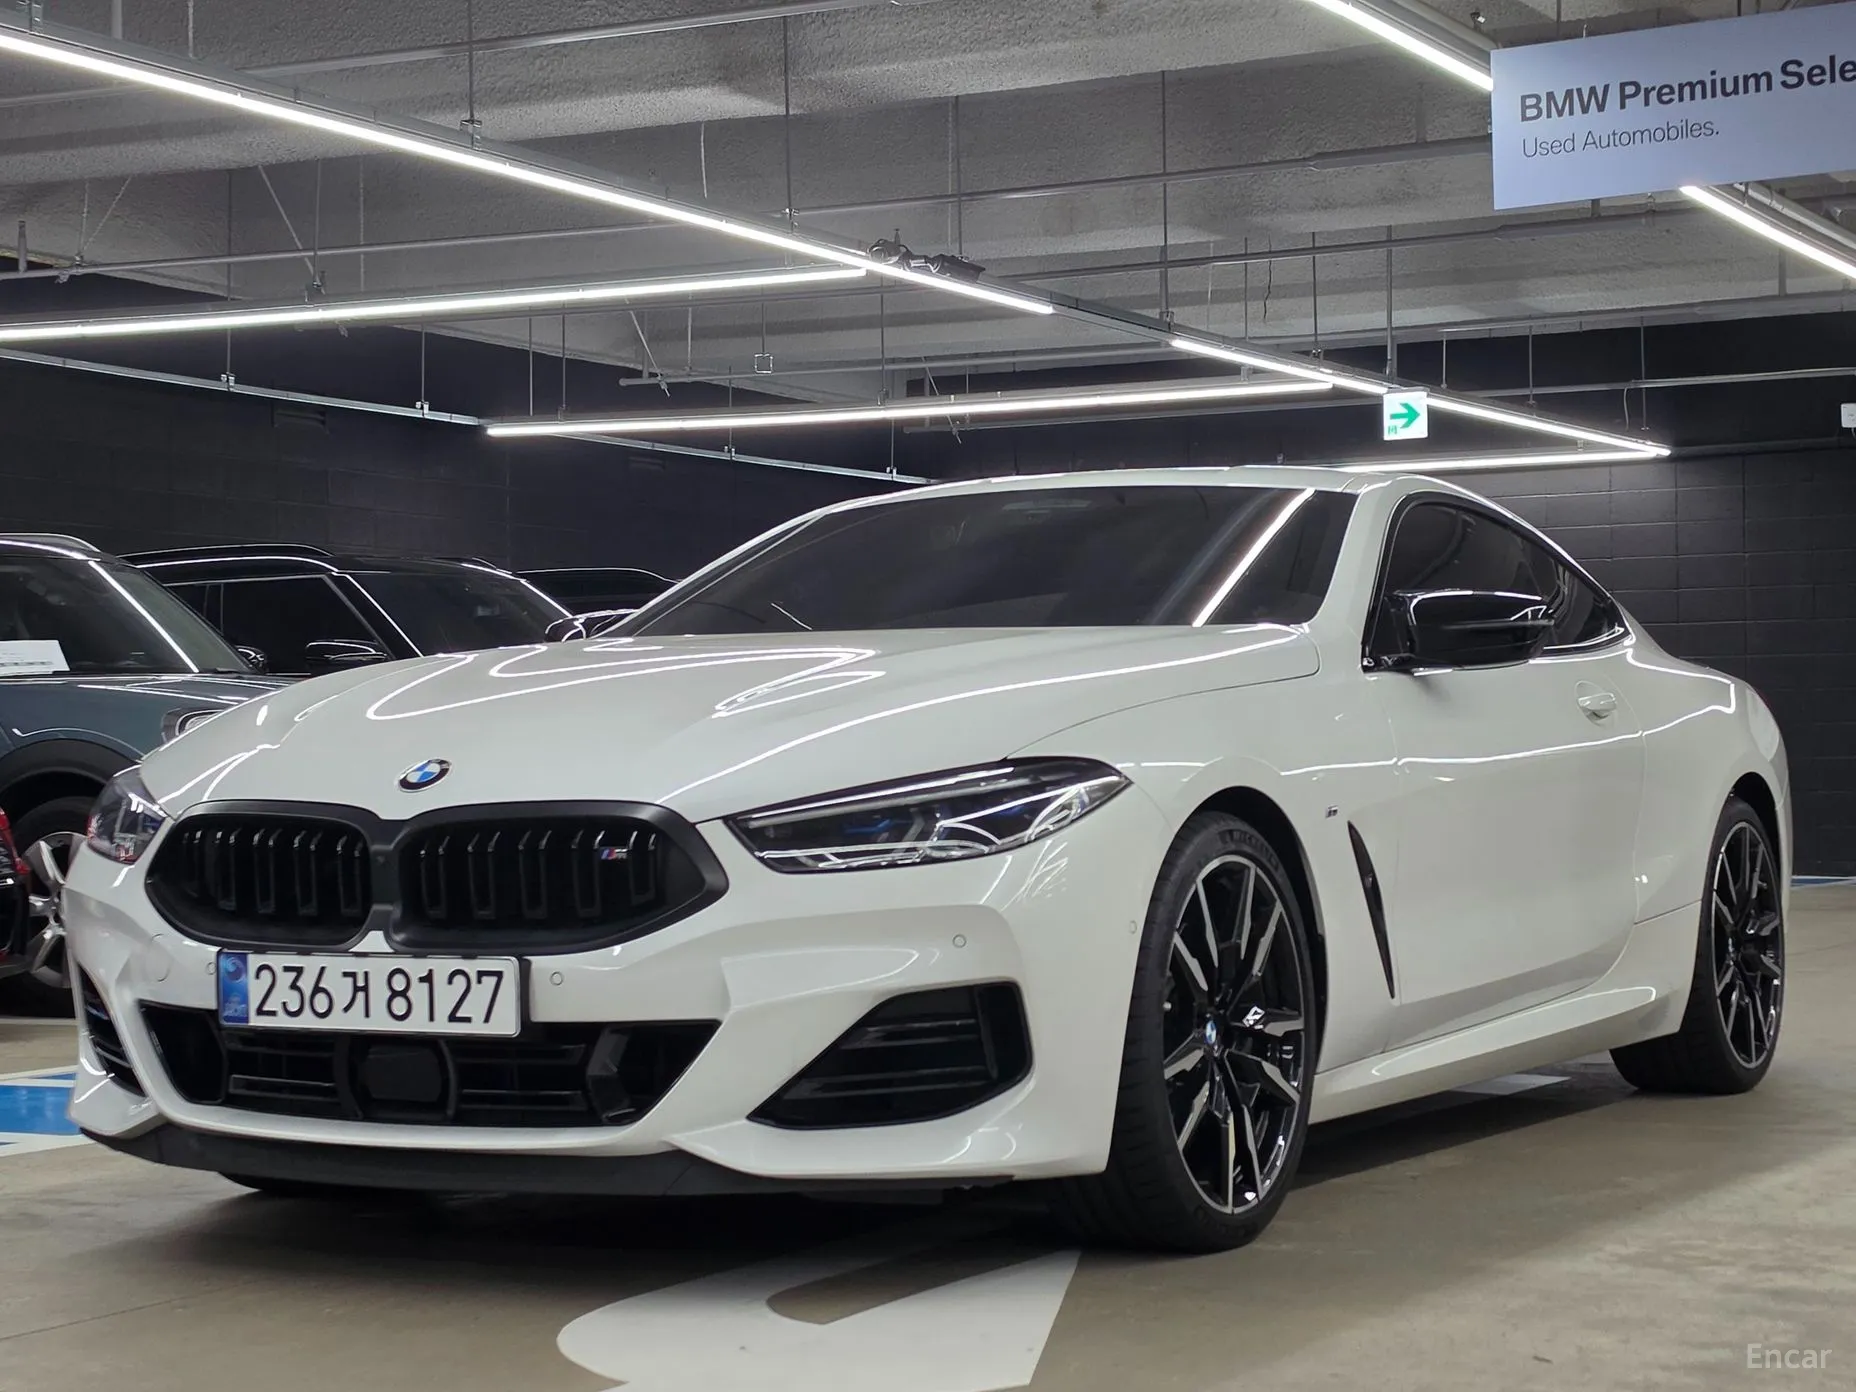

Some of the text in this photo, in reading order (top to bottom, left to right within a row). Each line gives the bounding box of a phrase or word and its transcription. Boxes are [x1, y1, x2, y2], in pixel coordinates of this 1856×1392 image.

[1520, 54, 1856, 122] BMW Premium Sele
[1522, 119, 1720, 158] Used Automobiles.
[385, 967, 504, 1024] 8127
